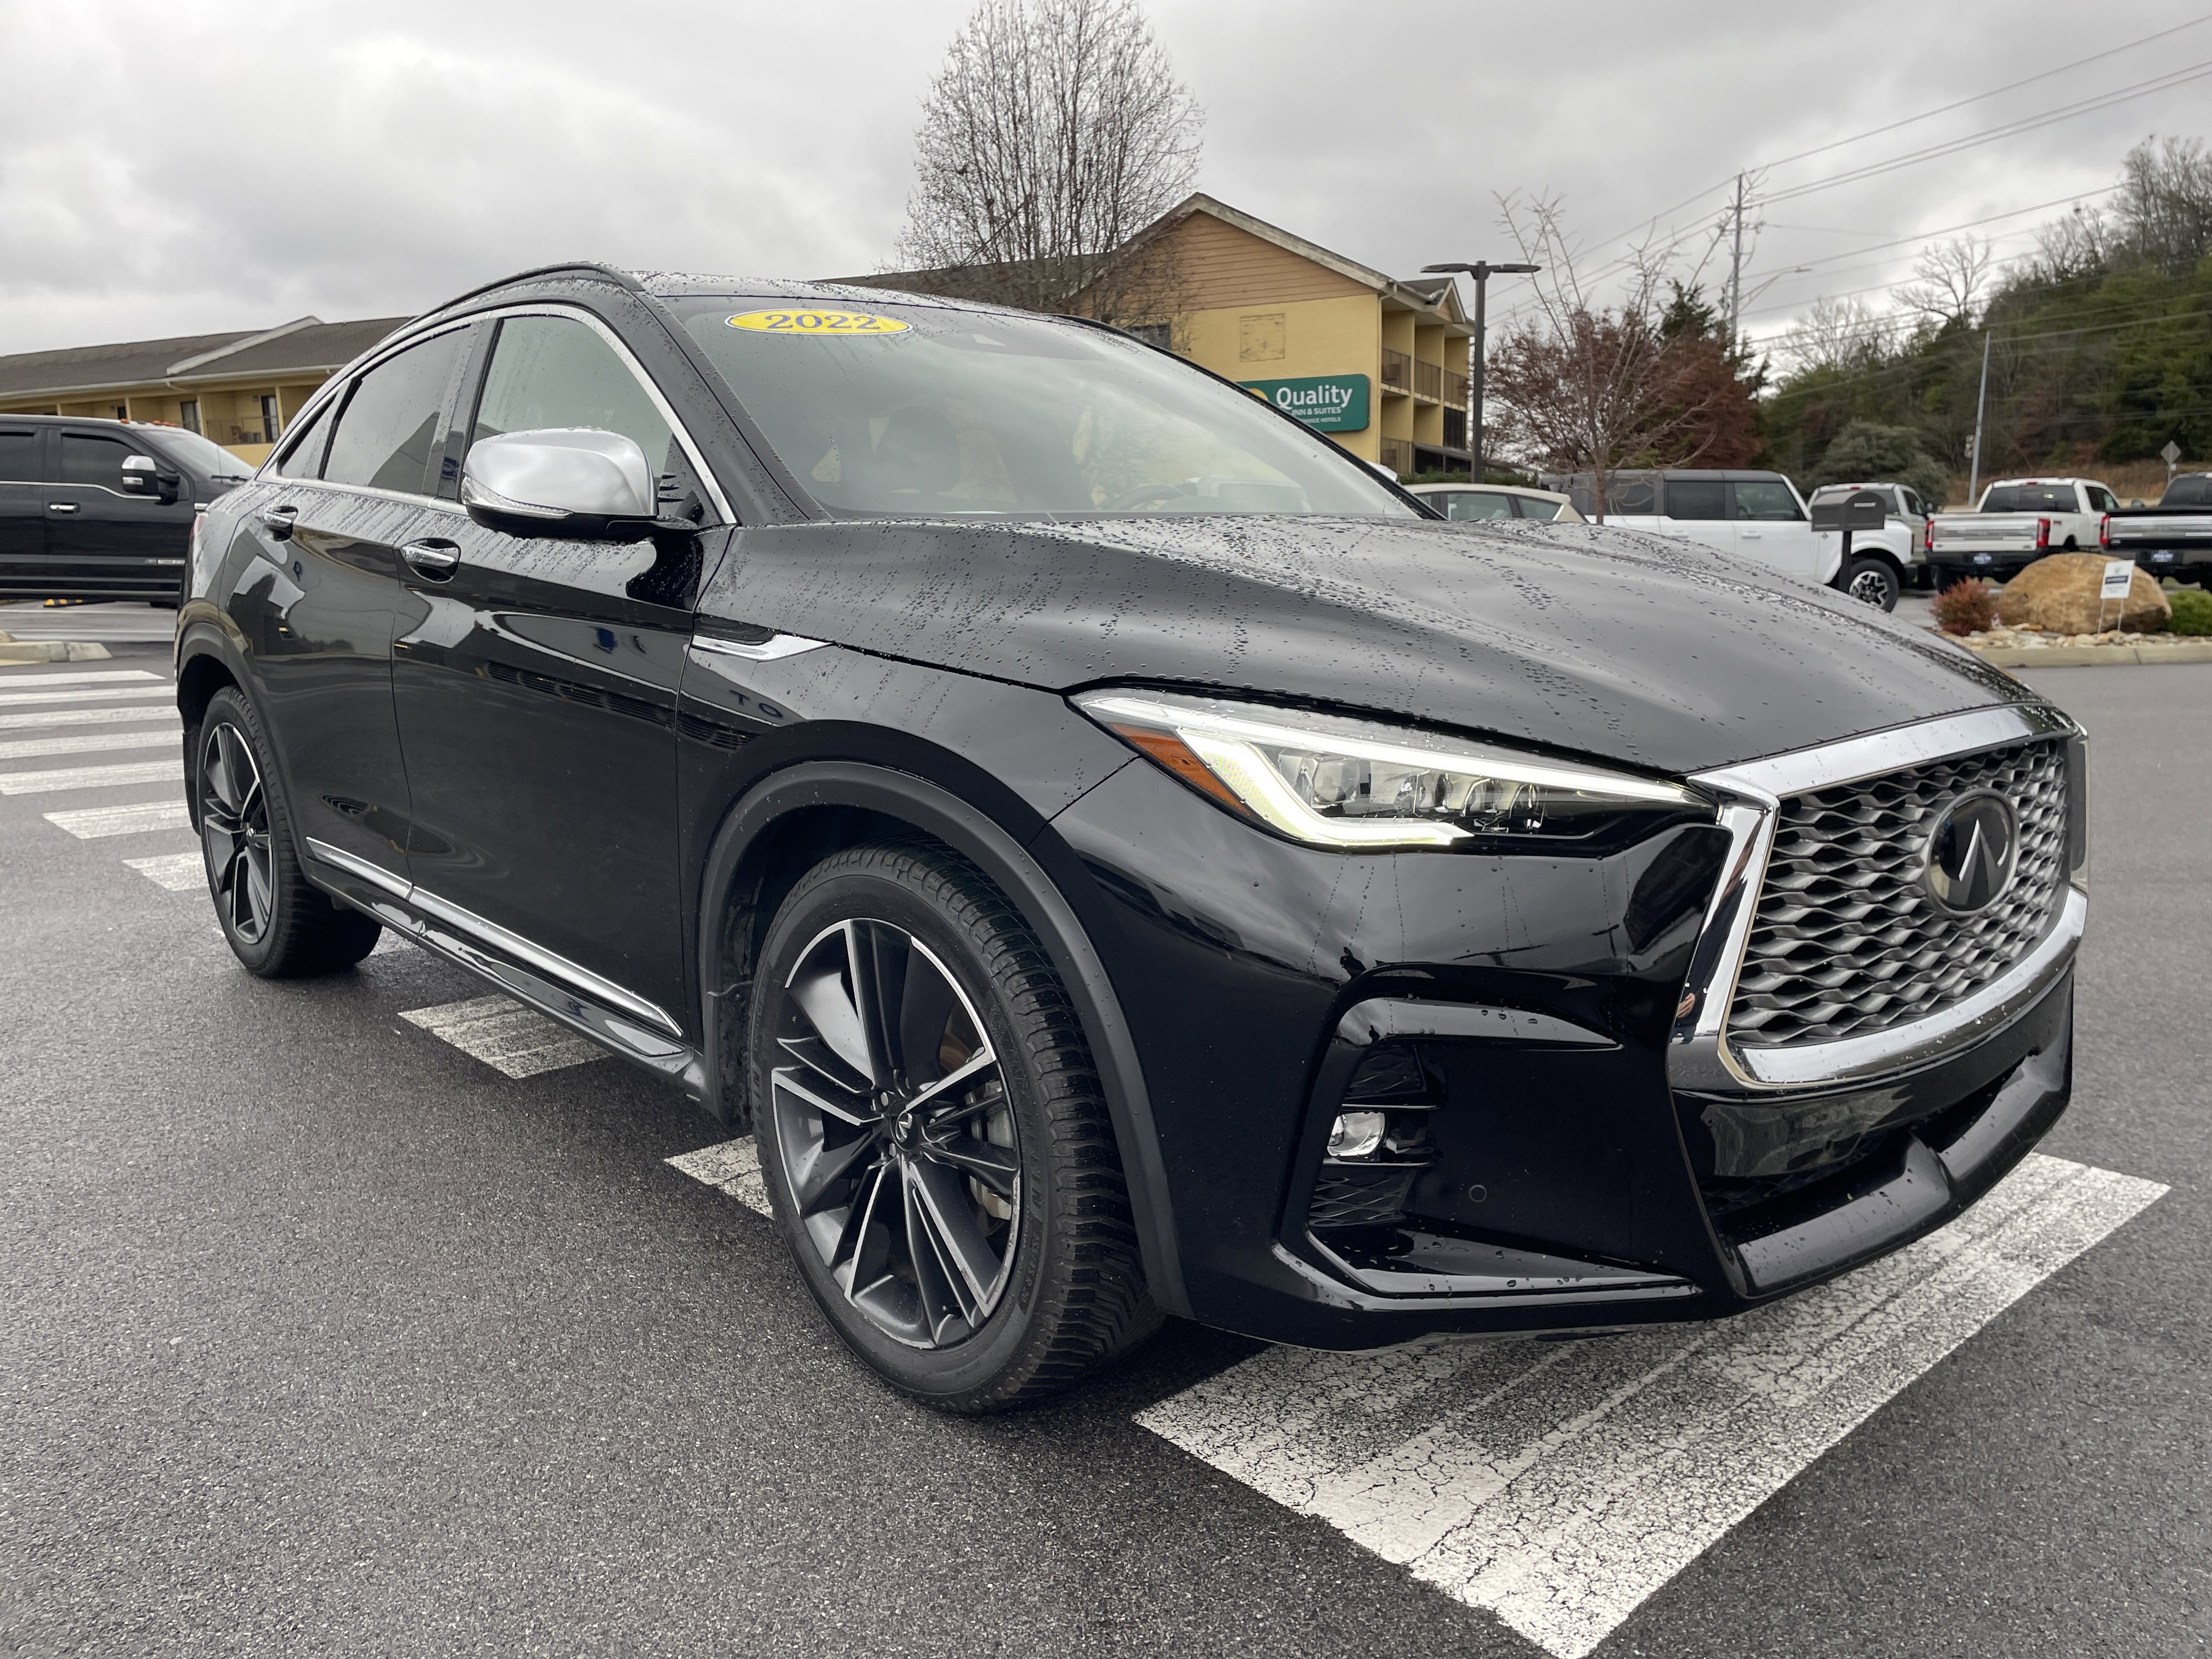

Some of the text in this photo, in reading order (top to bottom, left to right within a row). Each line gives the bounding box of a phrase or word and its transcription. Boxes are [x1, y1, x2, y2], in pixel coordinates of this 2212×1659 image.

[764, 314, 881, 329] 2022
[1276, 385, 1353, 410] Quality
[1313, 407, 1342, 415] SUITES
